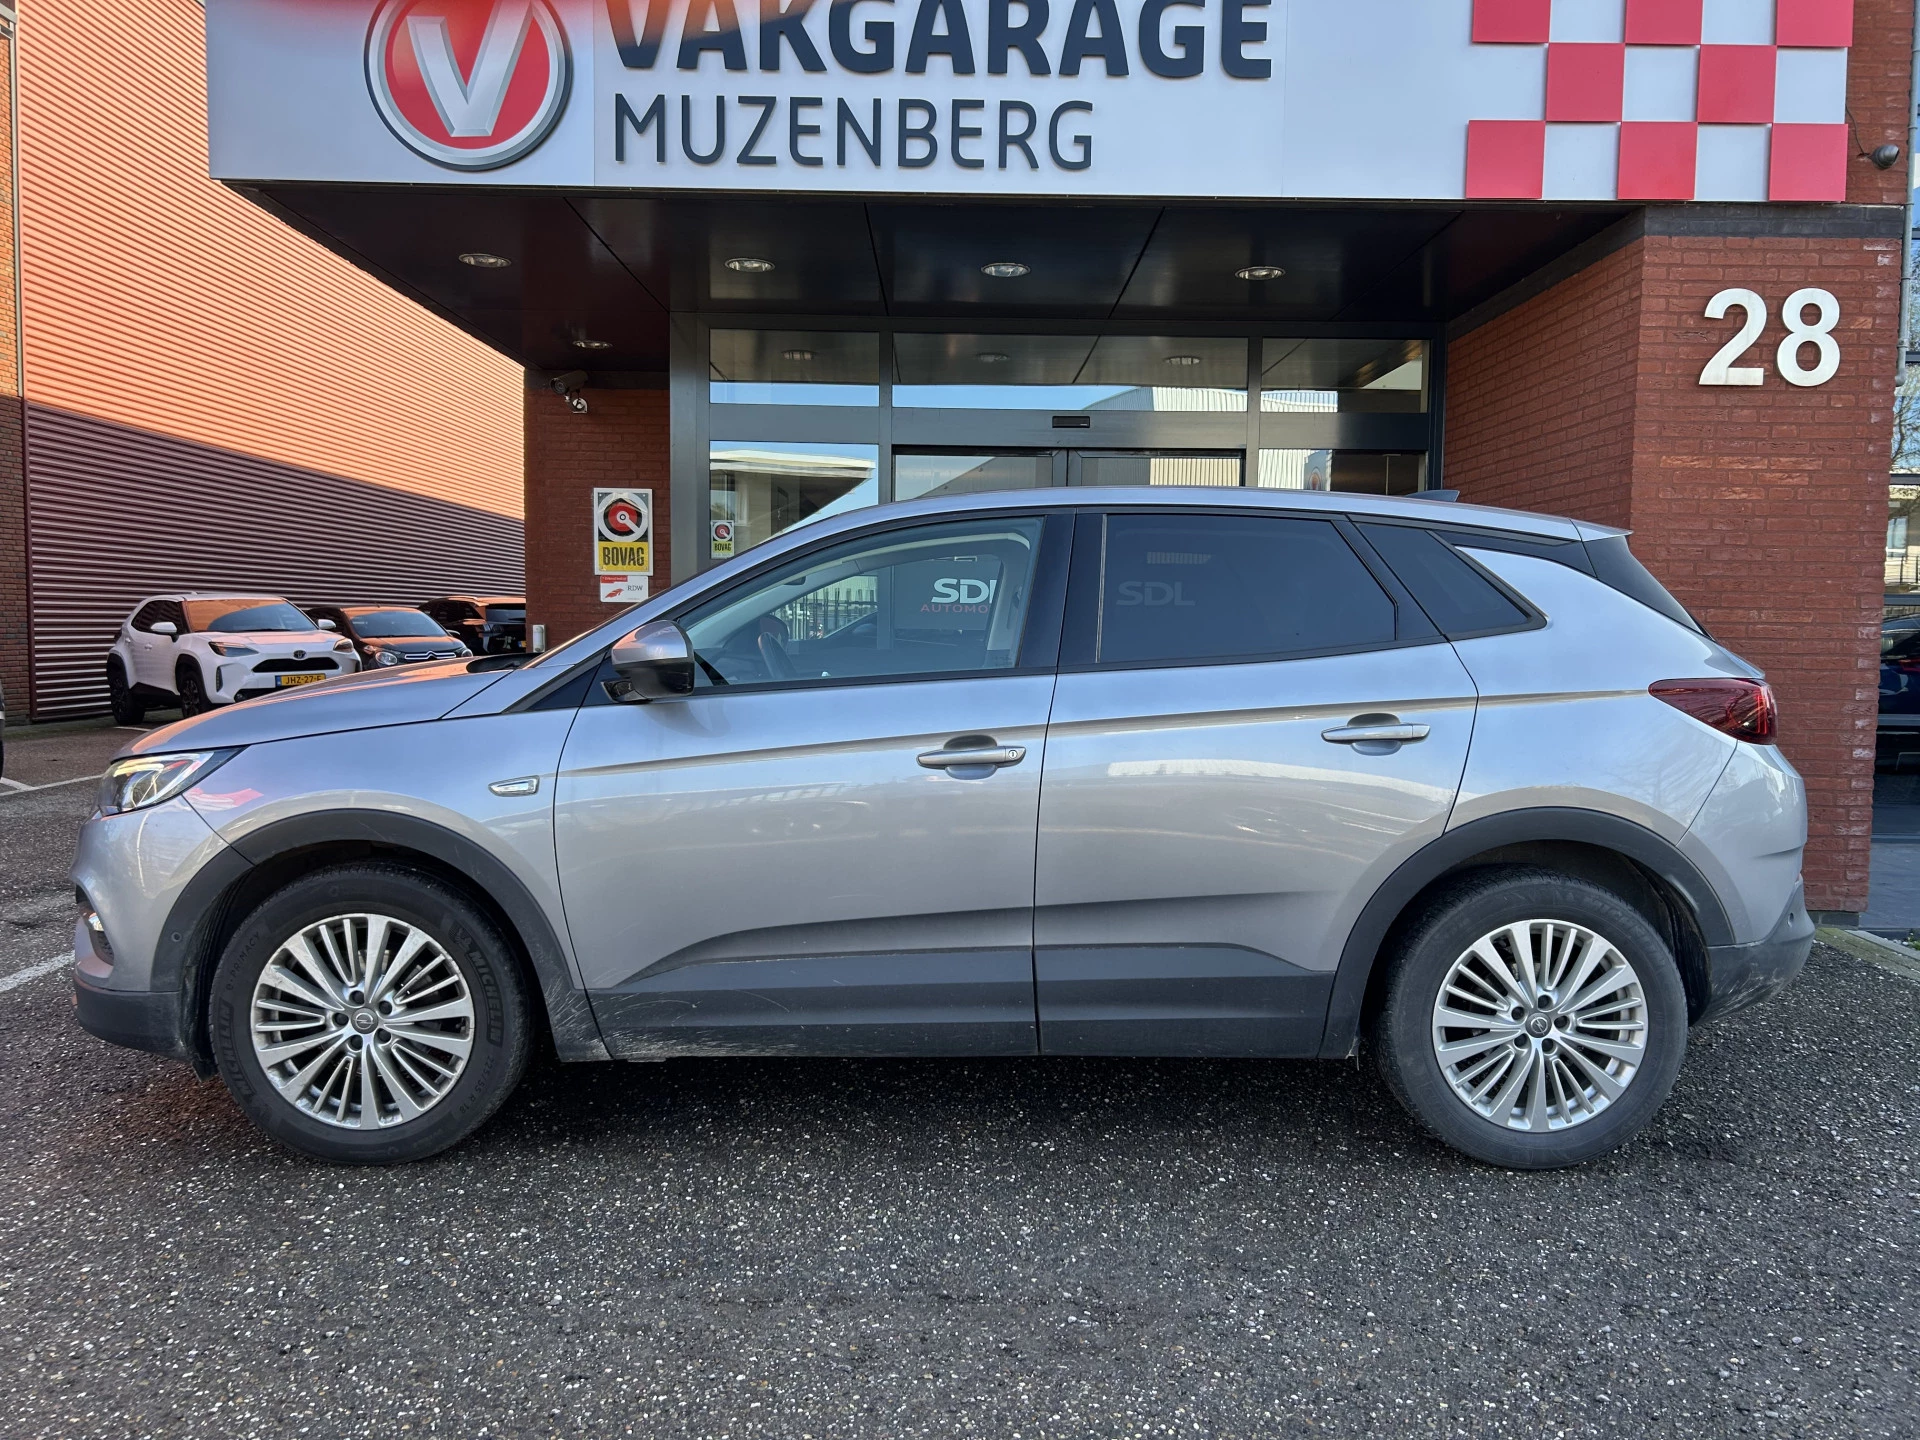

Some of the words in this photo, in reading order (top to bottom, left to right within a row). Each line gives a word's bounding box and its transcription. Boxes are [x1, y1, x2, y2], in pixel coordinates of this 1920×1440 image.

[610, 0, 1272, 79] VAKGARAGE
[613, 93, 1095, 171] MUZENBERG
[1699, 287, 1841, 387] 28
[603, 546, 645, 567] BOVAG
[714, 542, 732, 552] BOVAG
[920, 603, 989, 613] AUTOMO
[1116, 580, 1196, 606] SDL
[469, 950, 503, 1042] MICHELIN
[219, 1002, 254, 1095] MICHELIN
